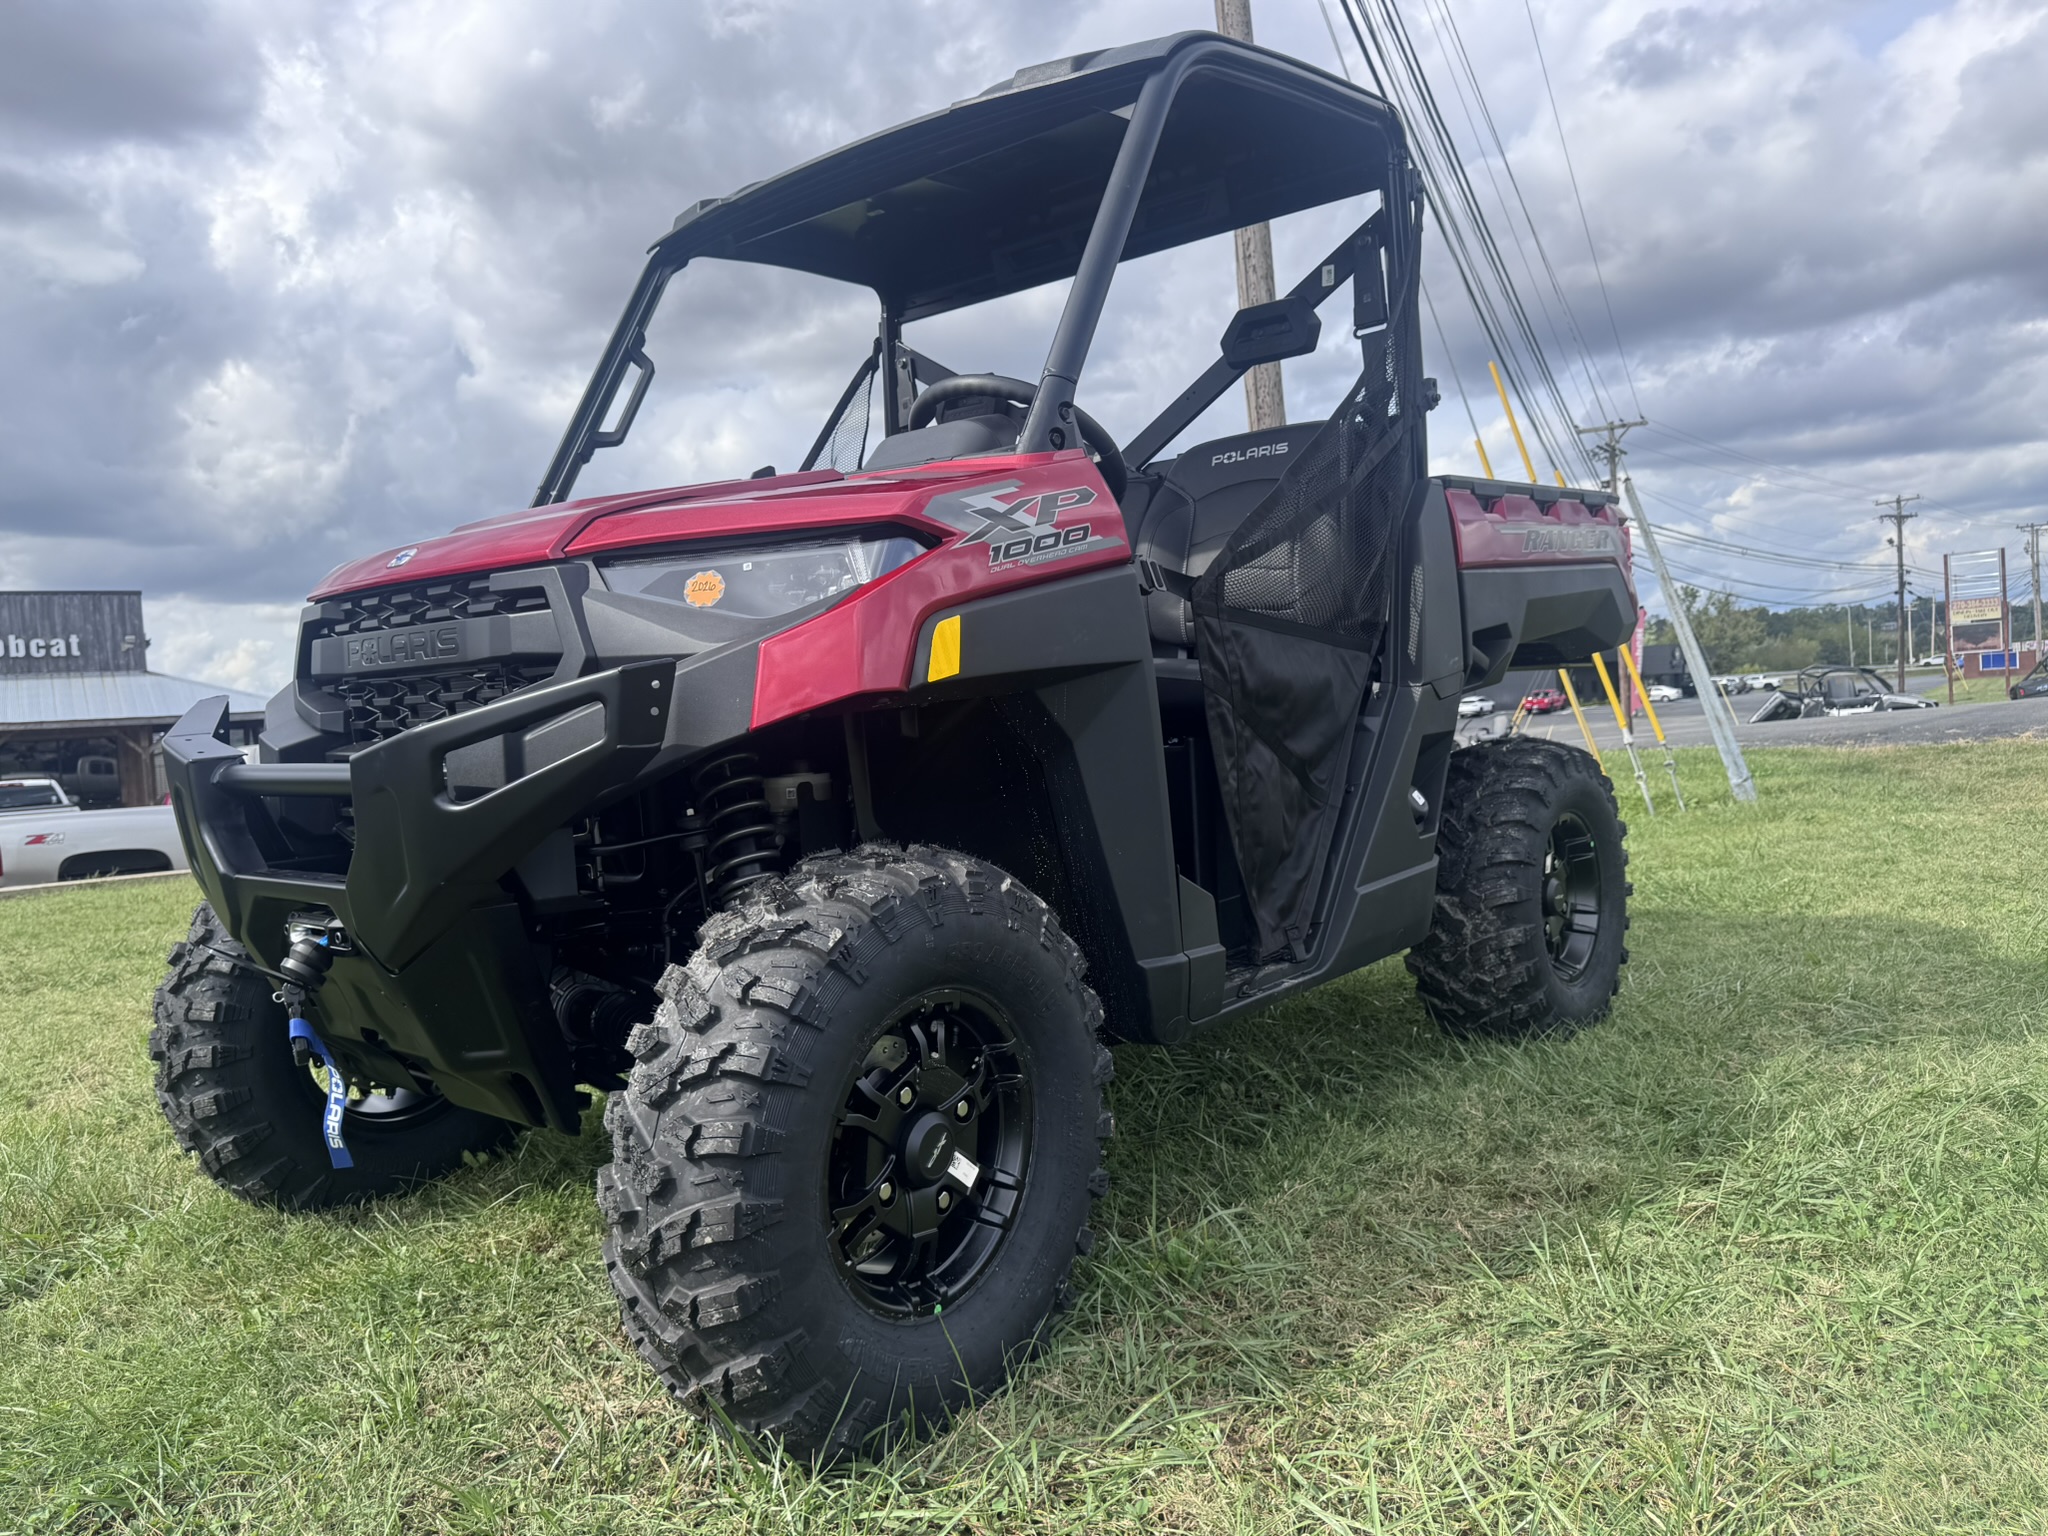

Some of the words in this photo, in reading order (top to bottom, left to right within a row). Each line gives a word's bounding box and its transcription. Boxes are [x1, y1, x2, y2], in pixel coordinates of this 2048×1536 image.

[1211, 442, 1289, 467] POLARIS
[950, 486, 1099, 550] XP
[988, 523, 1092, 566] 1000
[1522, 528, 1610, 553] RANGER
[990, 563, 1016, 574] DUAL
[1018, 548, 1067, 566] OVERHEAD
[1068, 543, 1089, 554] CAM
[691, 580, 717, 593] 2026
[0, 633, 81, 659] bcat
[347, 627, 460, 668] POLARIS
[325, 1063, 345, 1150] POLARIS
